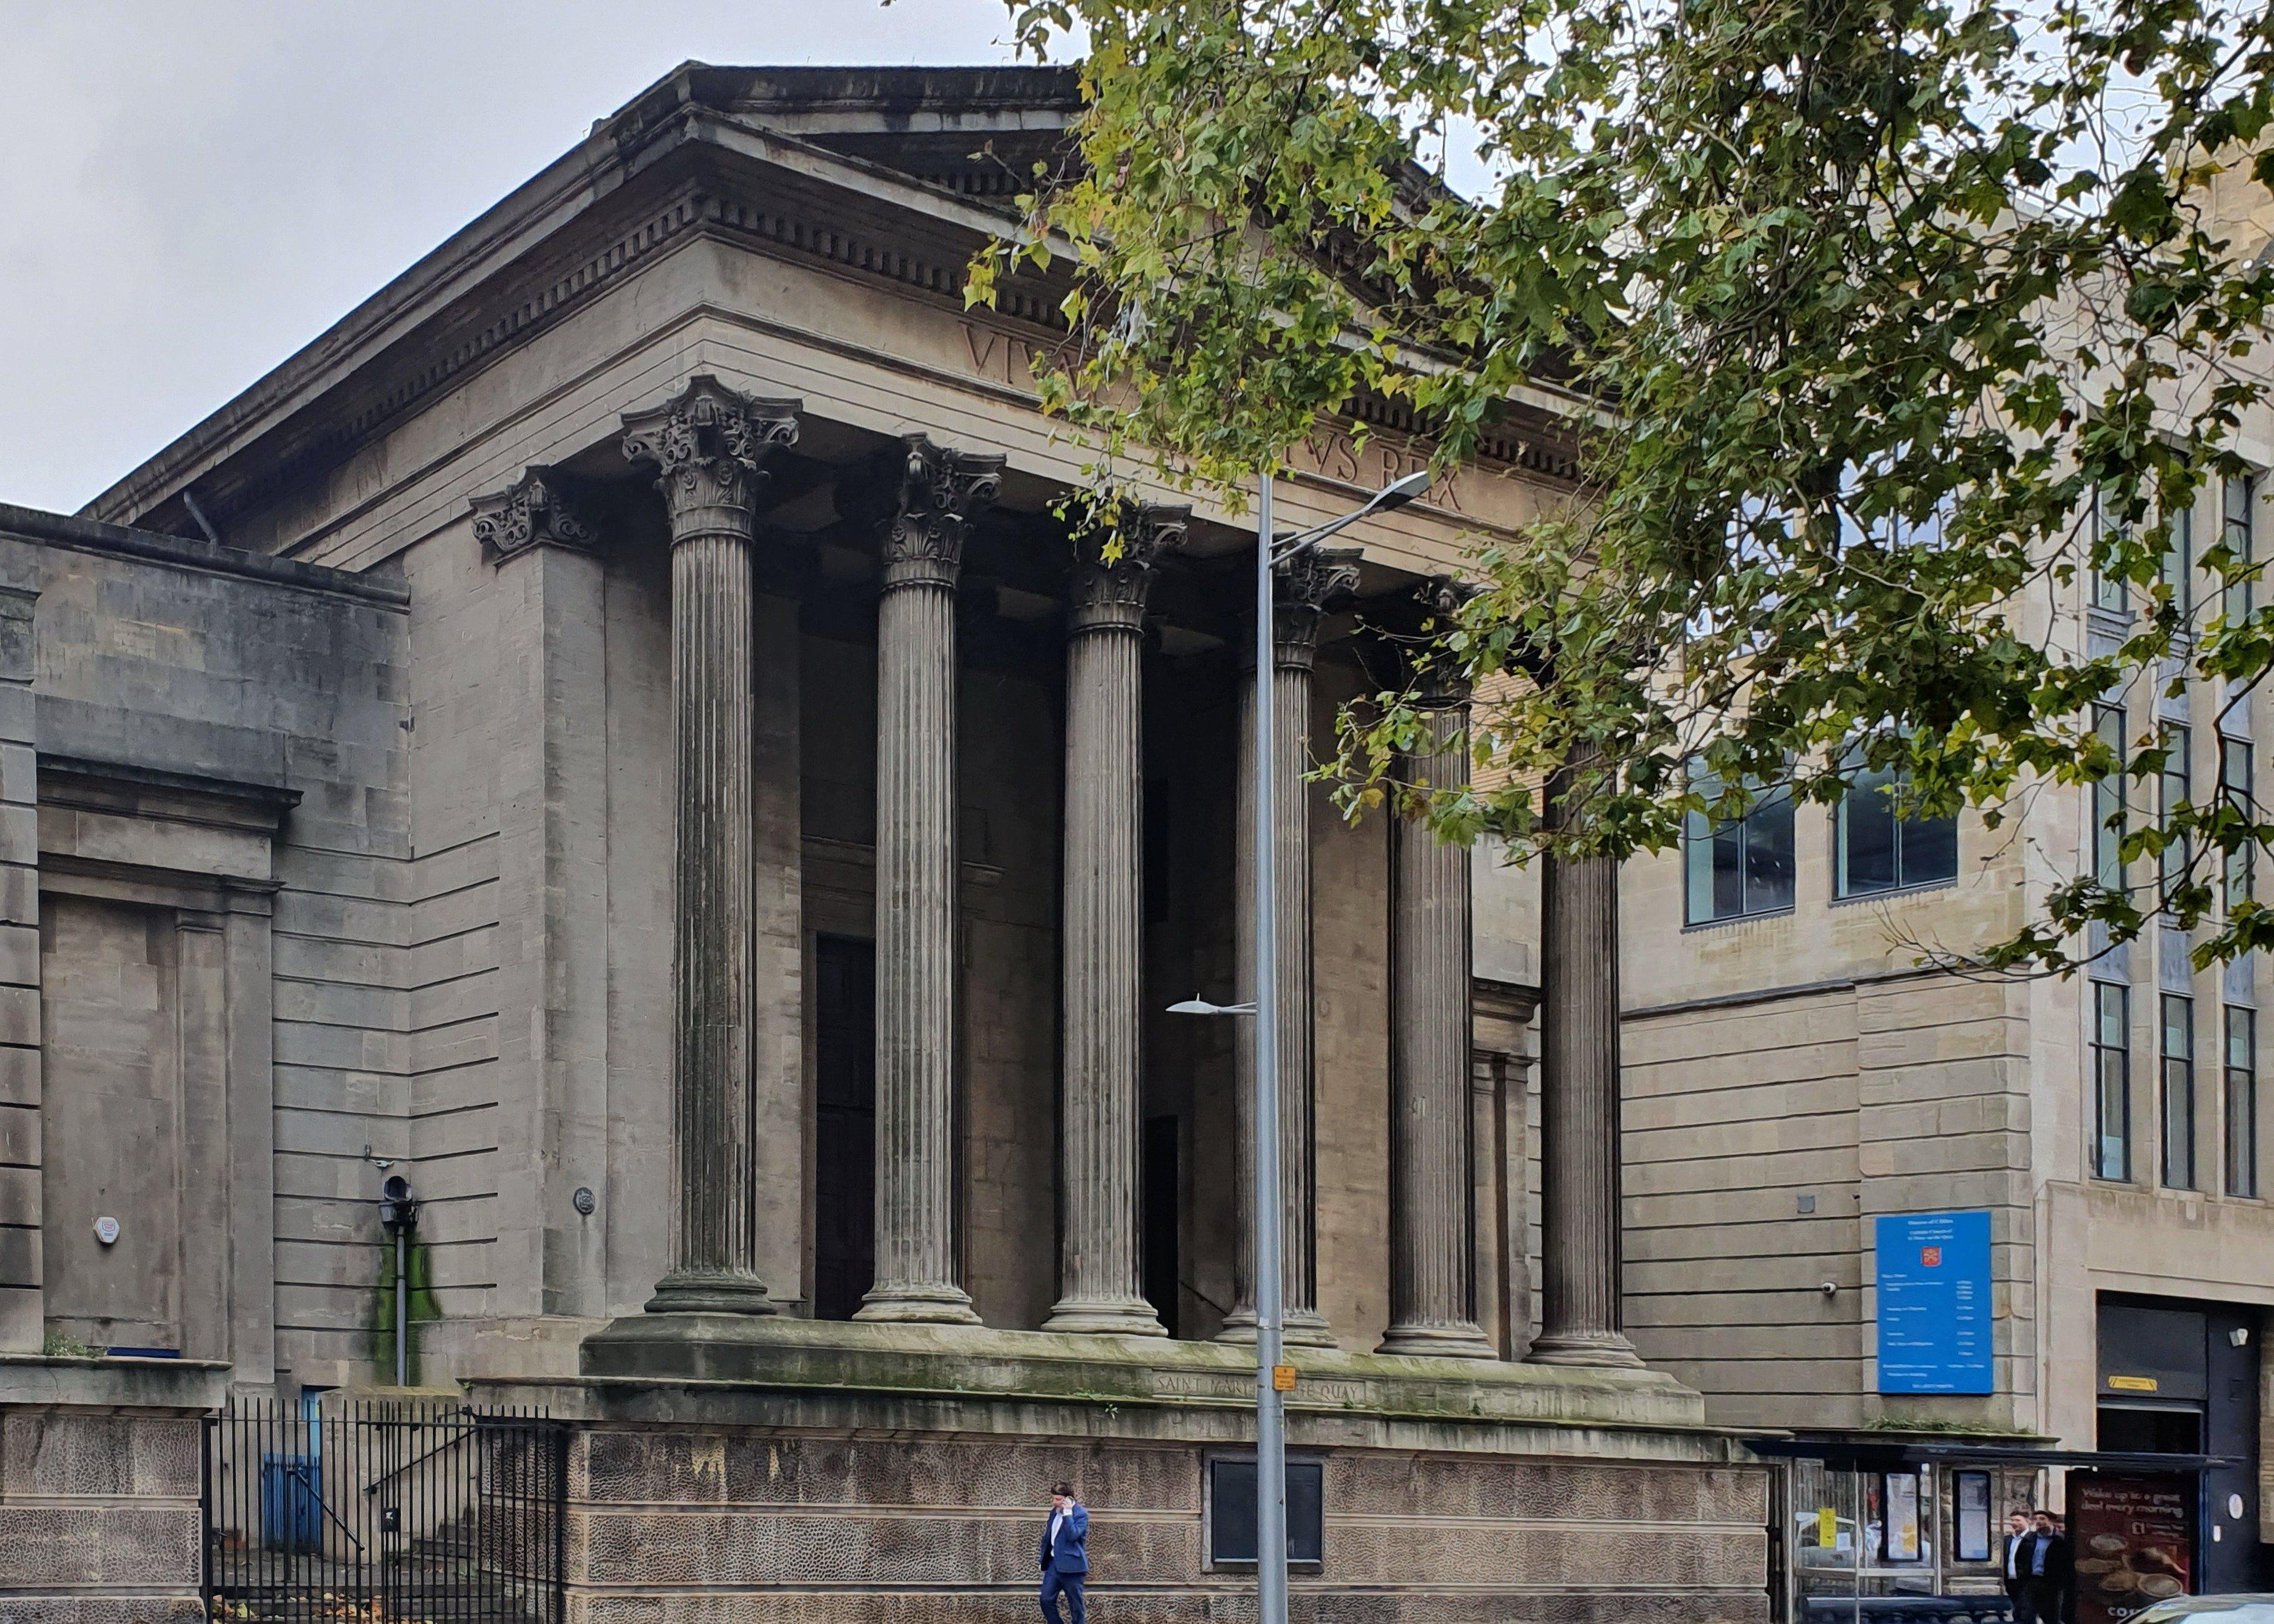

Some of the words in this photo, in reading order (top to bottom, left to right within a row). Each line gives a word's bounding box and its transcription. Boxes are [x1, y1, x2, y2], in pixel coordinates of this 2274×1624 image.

[1157, 1376, 1201, 1392] SAINT
[1210, 1378, 1250, 1397] MARY
[1320, 1383, 1358, 1402] QUAY
